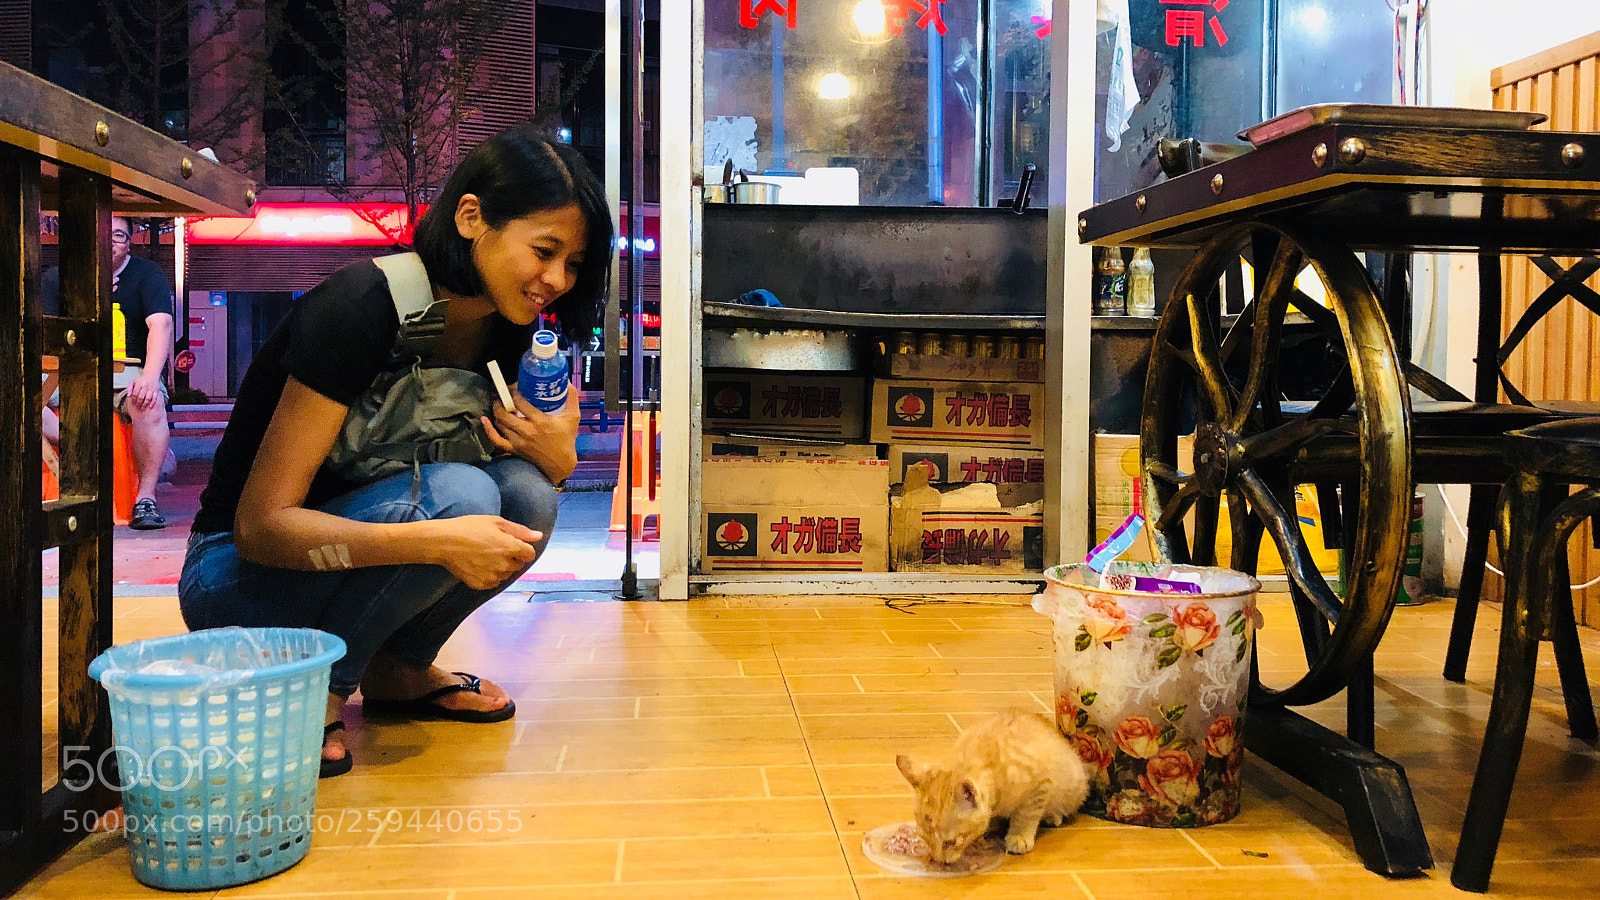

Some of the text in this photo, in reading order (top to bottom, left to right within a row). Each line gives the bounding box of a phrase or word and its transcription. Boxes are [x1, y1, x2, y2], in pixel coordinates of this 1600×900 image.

[762, 385, 842, 419] オガ備長
[945, 391, 1032, 428] オガ備長
[770, 516, 863, 555] オガ備長
[921, 528, 1011, 566] オガ備長
